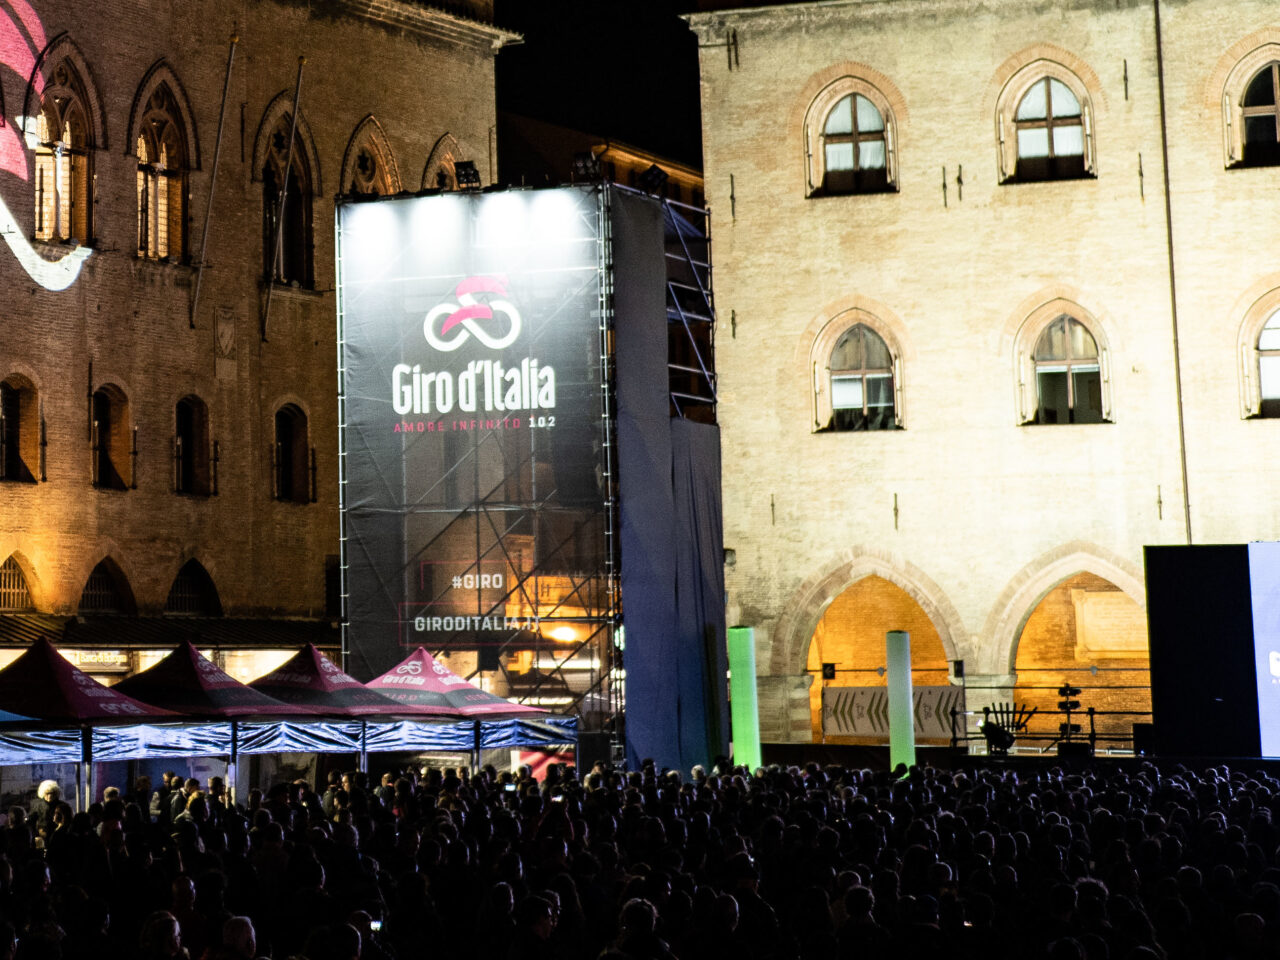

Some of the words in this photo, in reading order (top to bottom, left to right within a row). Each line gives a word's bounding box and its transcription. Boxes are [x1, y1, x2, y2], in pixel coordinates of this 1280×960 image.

[392, 363, 454, 415] Giro
[458, 357, 556, 412] d'Italia
[393, 421, 445, 433] AMORE
[452, 418, 521, 432] INFINITO
[528, 416, 556, 428] 102
[452, 573, 503, 589] #GIRO
[414, 615, 540, 632] GIRODITALIA.IT
